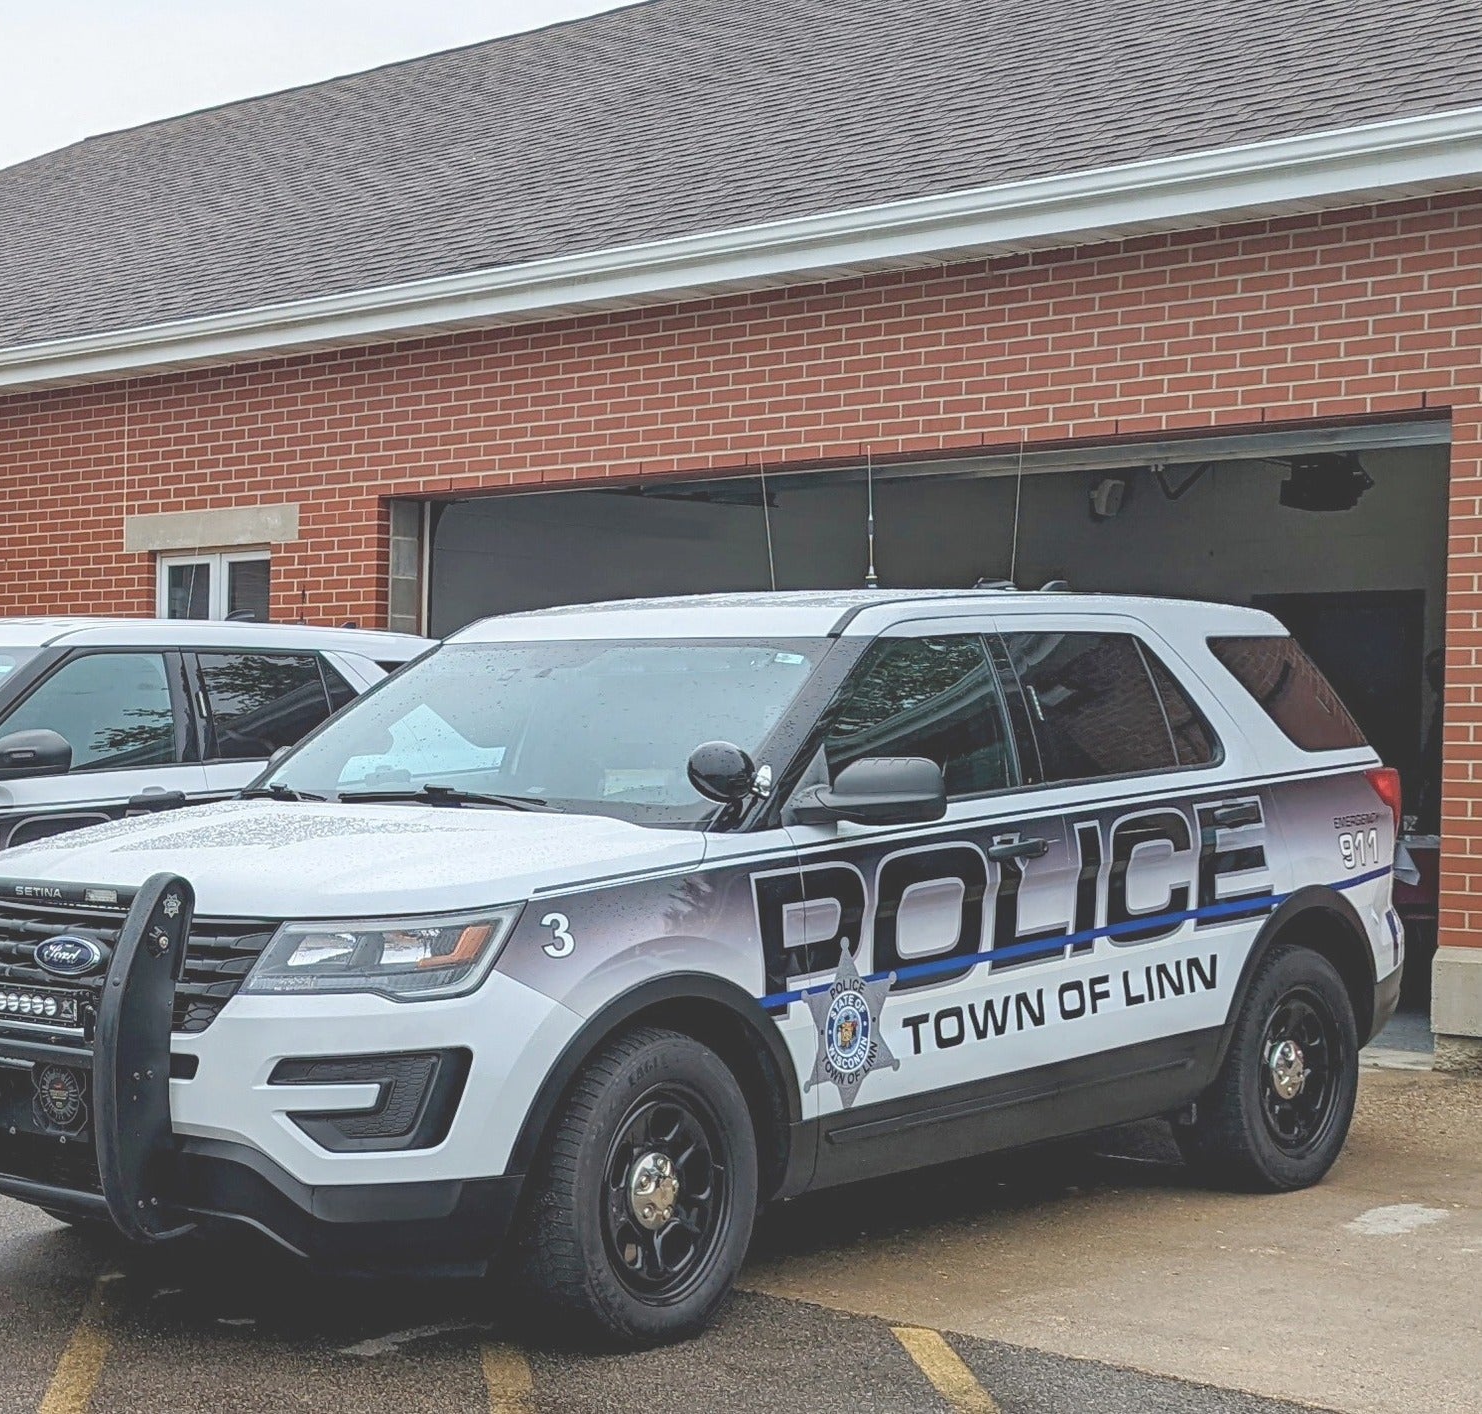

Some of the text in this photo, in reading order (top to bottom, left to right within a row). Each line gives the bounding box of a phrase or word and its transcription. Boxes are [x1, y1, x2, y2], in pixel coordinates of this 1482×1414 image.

[1338, 827, 1379, 870] 911
[15, 885, 63, 899] SETINA
[749, 795, 1278, 1020] POLICE
[43, 943, 82, 965] Ford
[540, 912, 575, 959] 3
[829, 979, 867, 1000] POLICE
[830, 995, 866, 1020] STATE OF
[901, 954, 1218, 1056] TOWN OF LINN
[822, 1041, 878, 1085] TOWN OF LINN
[827, 1036, 868, 1069] WISCONSIN
